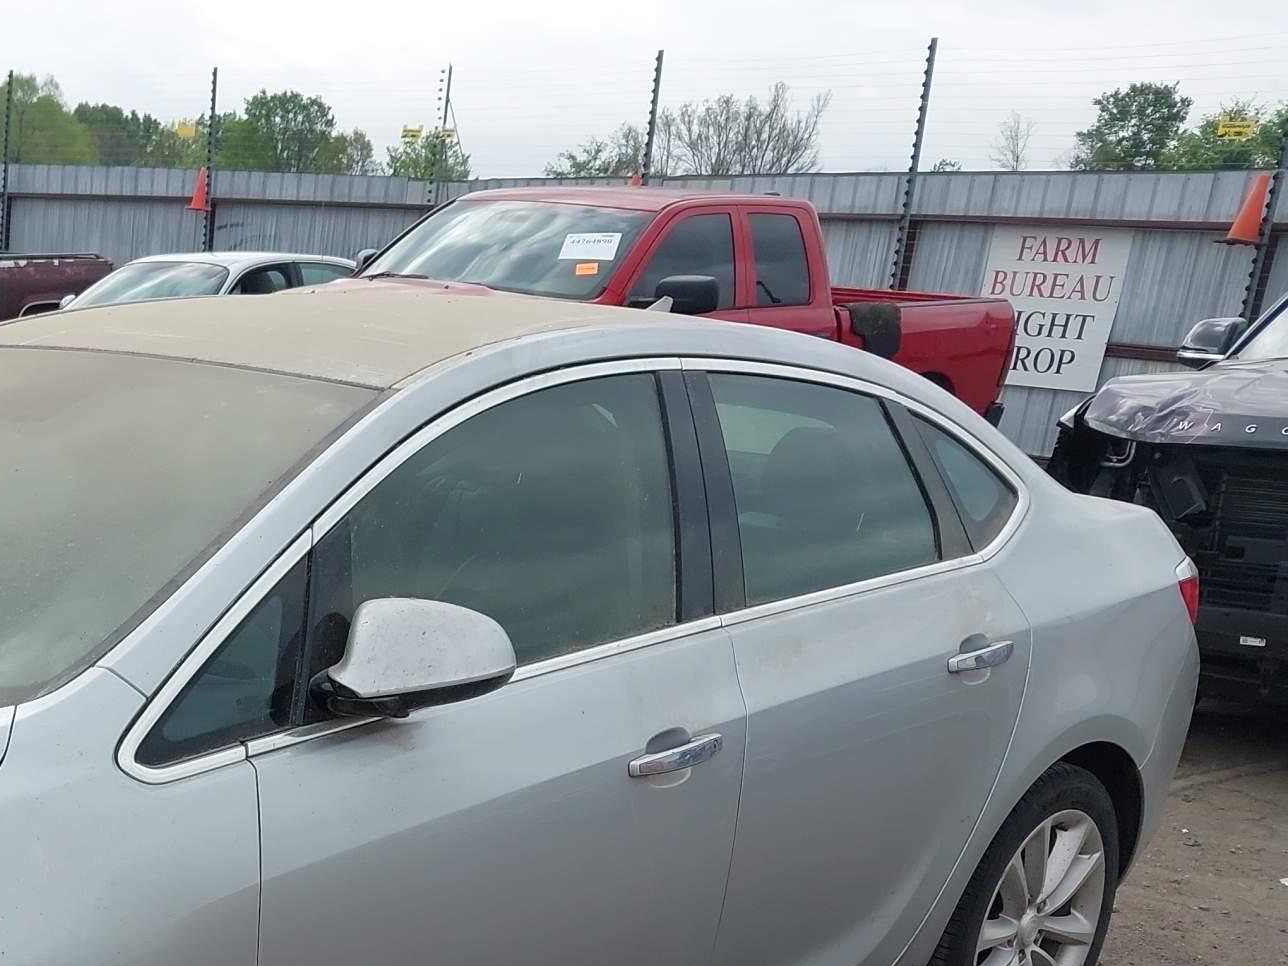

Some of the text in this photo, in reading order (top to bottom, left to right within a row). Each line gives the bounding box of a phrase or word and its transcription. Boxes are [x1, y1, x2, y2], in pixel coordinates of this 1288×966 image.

[1016, 235, 1102, 265] FARM
[990, 270, 1115, 302] BUREAU
[1015, 310, 1095, 340] IGHT
[1010, 345, 1075, 375] ROP
